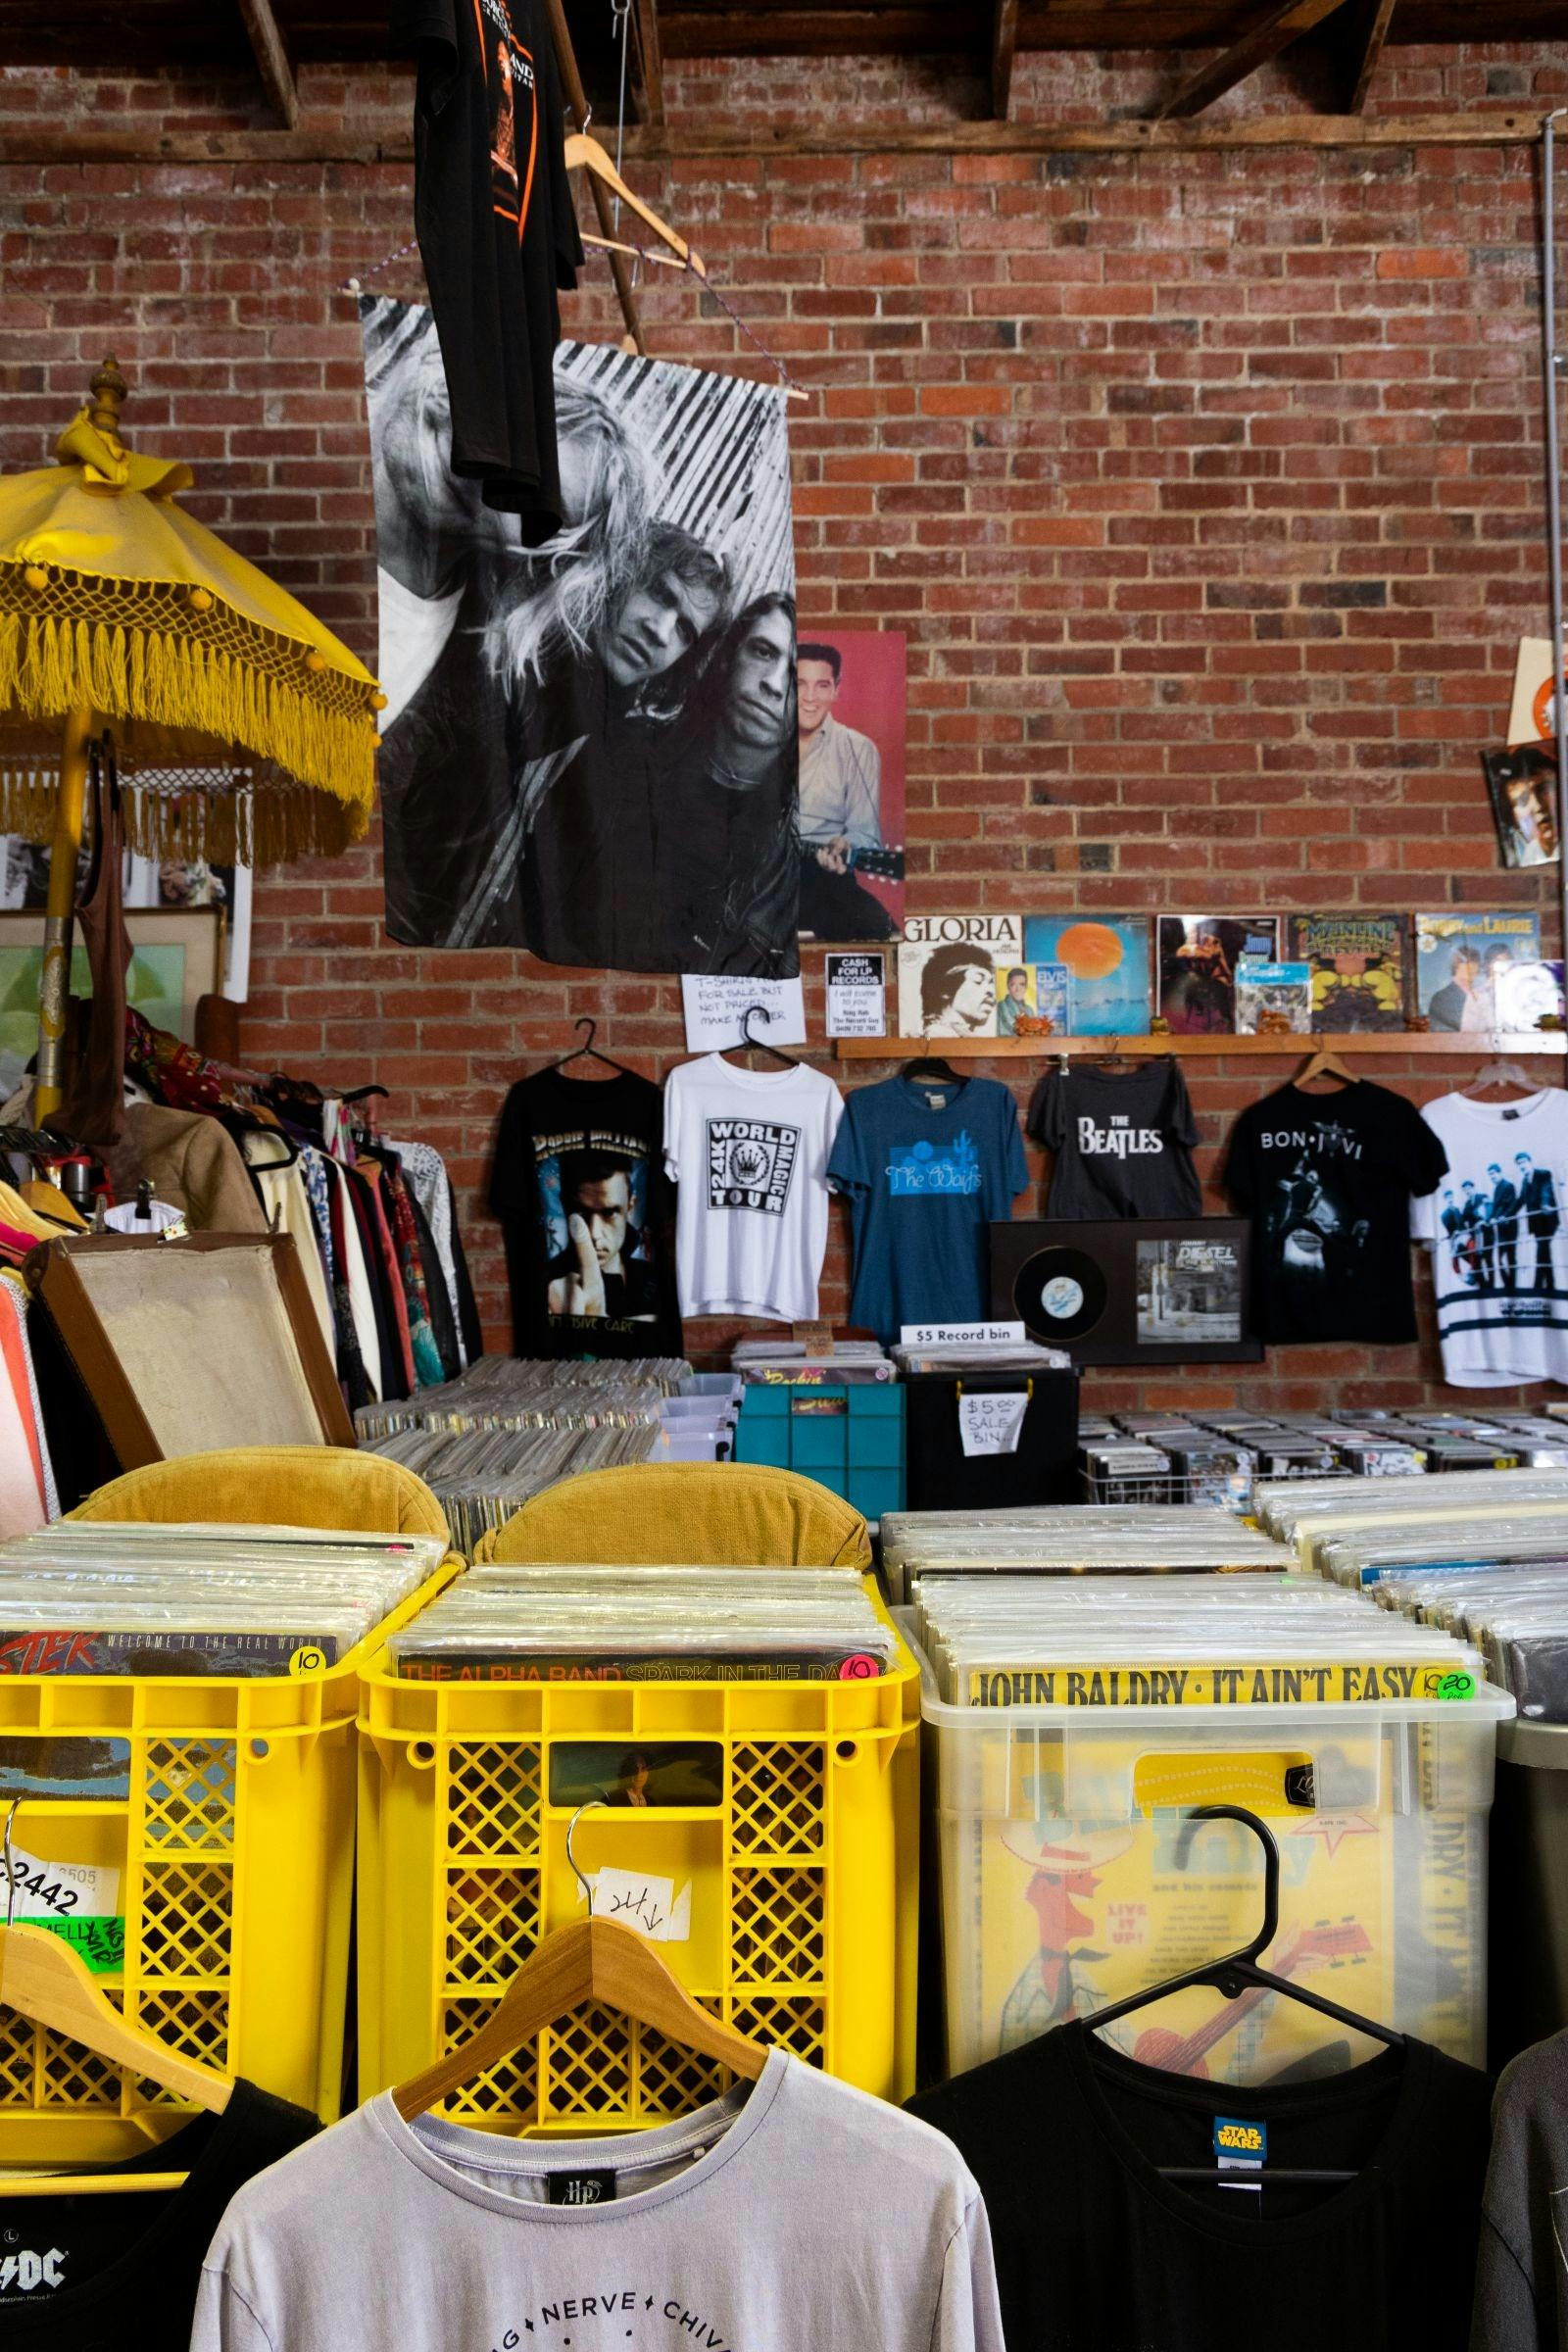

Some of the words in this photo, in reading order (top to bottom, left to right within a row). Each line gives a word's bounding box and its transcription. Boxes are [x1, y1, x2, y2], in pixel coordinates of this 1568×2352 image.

[903, 917, 1016, 943] GLORIA
[842, 958, 869, 967] CASH
[838, 967, 858, 976] FOR
[859, 967, 873, 976] LP
[831, 976, 879, 985] RECORDS
[698, 990, 724, 1000] FOR
[726, 987, 759, 998] SALE
[760, 985, 783, 995] BUT
[700, 1014, 732, 1025] MAKE
[1109, 1115, 1129, 1126] THE
[710, 1122, 796, 1146] WORLD
[710, 1140, 726, 1189] 24K
[769, 1145, 794, 1196] MAGIC
[885, 1165, 924, 1189] The
[711, 1189, 783, 1211] TOUR
[916, 1330, 933, 1342] $5
[938, 1328, 984, 1342] Record
[989, 1327, 1010, 1340] bin
[968, 1417, 1011, 1431] SALE
[107, 1634, 172, 1648] WELCOME
[181, 1636, 195, 1648] TO
[205, 1636, 227, 1649] THE
[237, 1637, 270, 1649] REAL
[298, 1652, 318, 1669] 10
[848, 1659, 870, 1678] 10
[401, 1664, 452, 1681] THE
[972, 1673, 1055, 1707] JOHN
[1066, 1671, 1189, 1706] BALDRY
[1212, 1670, 1245, 1704] IT
[1250, 1668, 1333, 1703] AIN'T
[1342, 1666, 1418, 1701] EASY
[1444, 1674, 1471, 1691] 20
[1107, 1904, 1147, 1917] LIVE
[1118, 1918, 1135, 1932] IT
[1112, 1934, 1145, 1945] UP!
[1217, 2130, 1262, 2150] WARS
[1223, 2125, 1258, 2139] STAR
[541, 2291, 637, 2325] NERVE
[663, 2301, 732, 2352] CHIV
